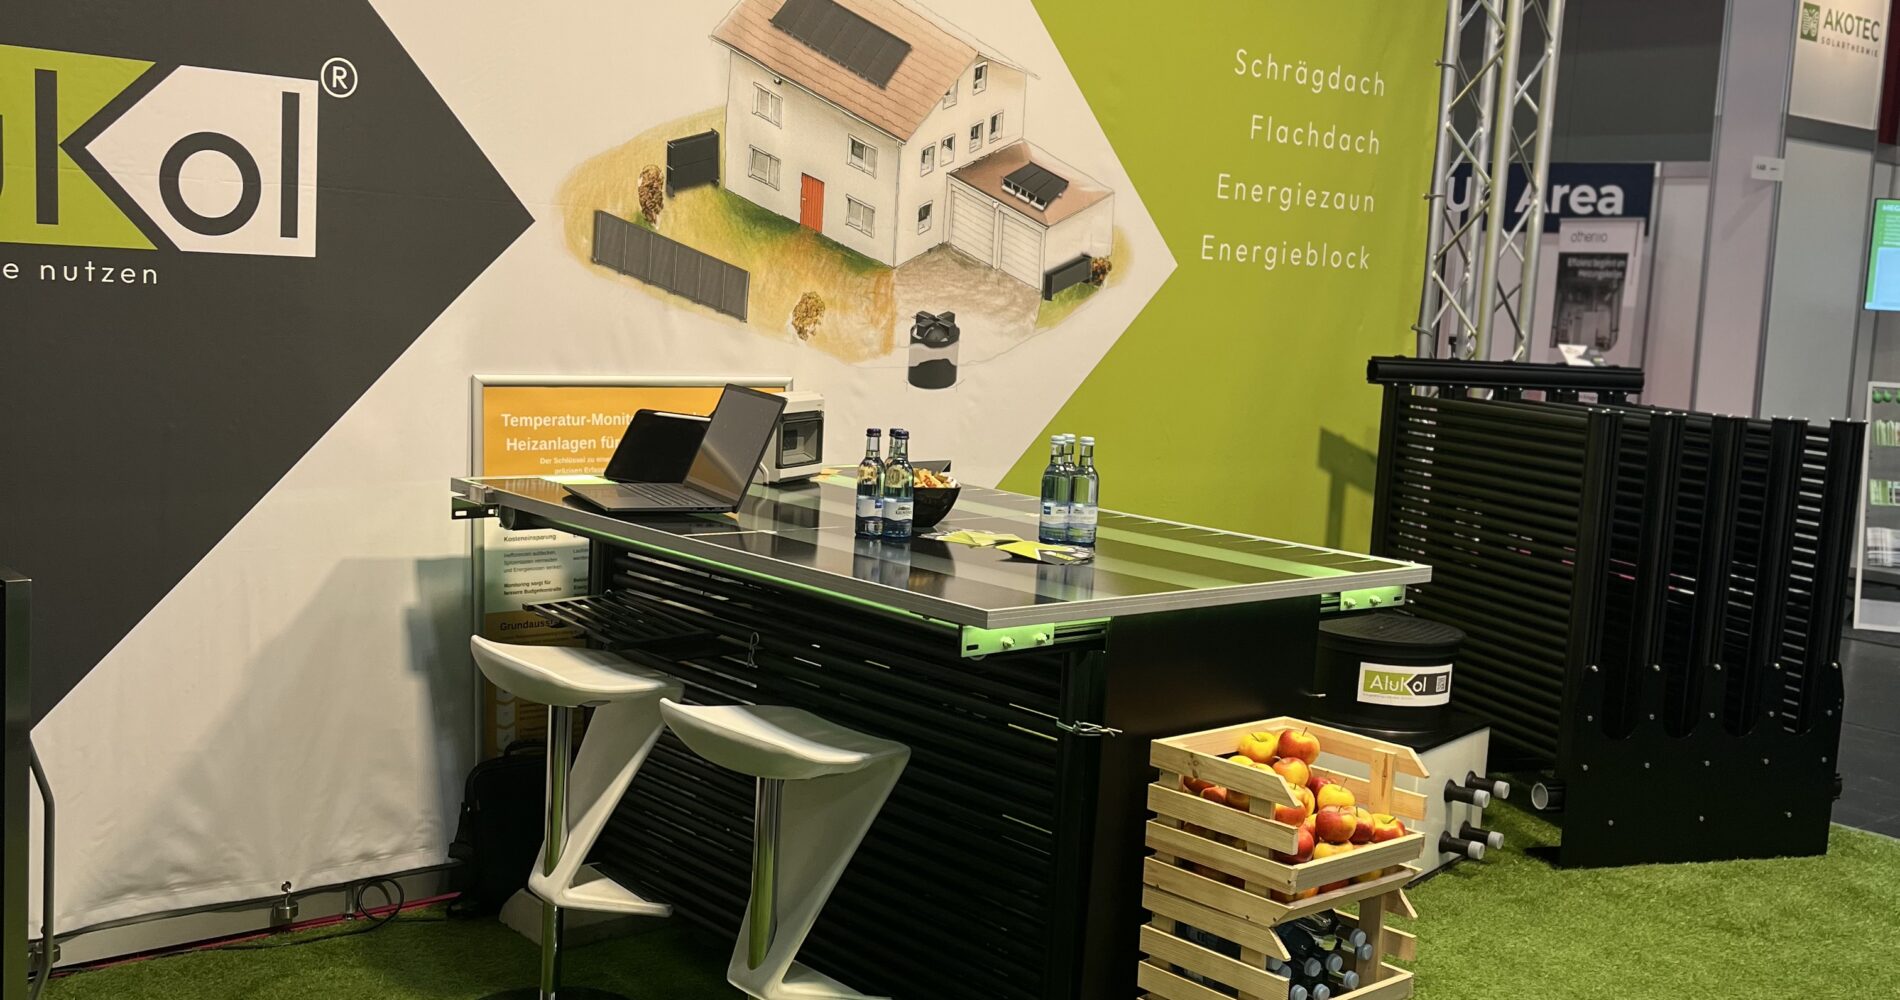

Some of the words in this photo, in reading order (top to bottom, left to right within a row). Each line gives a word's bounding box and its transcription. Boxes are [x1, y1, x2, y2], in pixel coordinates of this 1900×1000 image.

[1823, 8, 1880, 42] AKOTEC
[1234, 48, 1385, 97] Schrägdach
[1250, 114, 1380, 155] Flachdach
[1217, 173, 1375, 213] Energiezaun
[1514, 182, 1624, 216] Area
[1201, 234, 1370, 271] Energieblock
[40, 261, 158, 285] nutzen
[506, 437, 596, 453] Heizanlagen
[601, 436, 621, 450] für
[503, 533, 556, 543] Kosteneinsparung
[1370, 674, 1427, 696] AluKol
